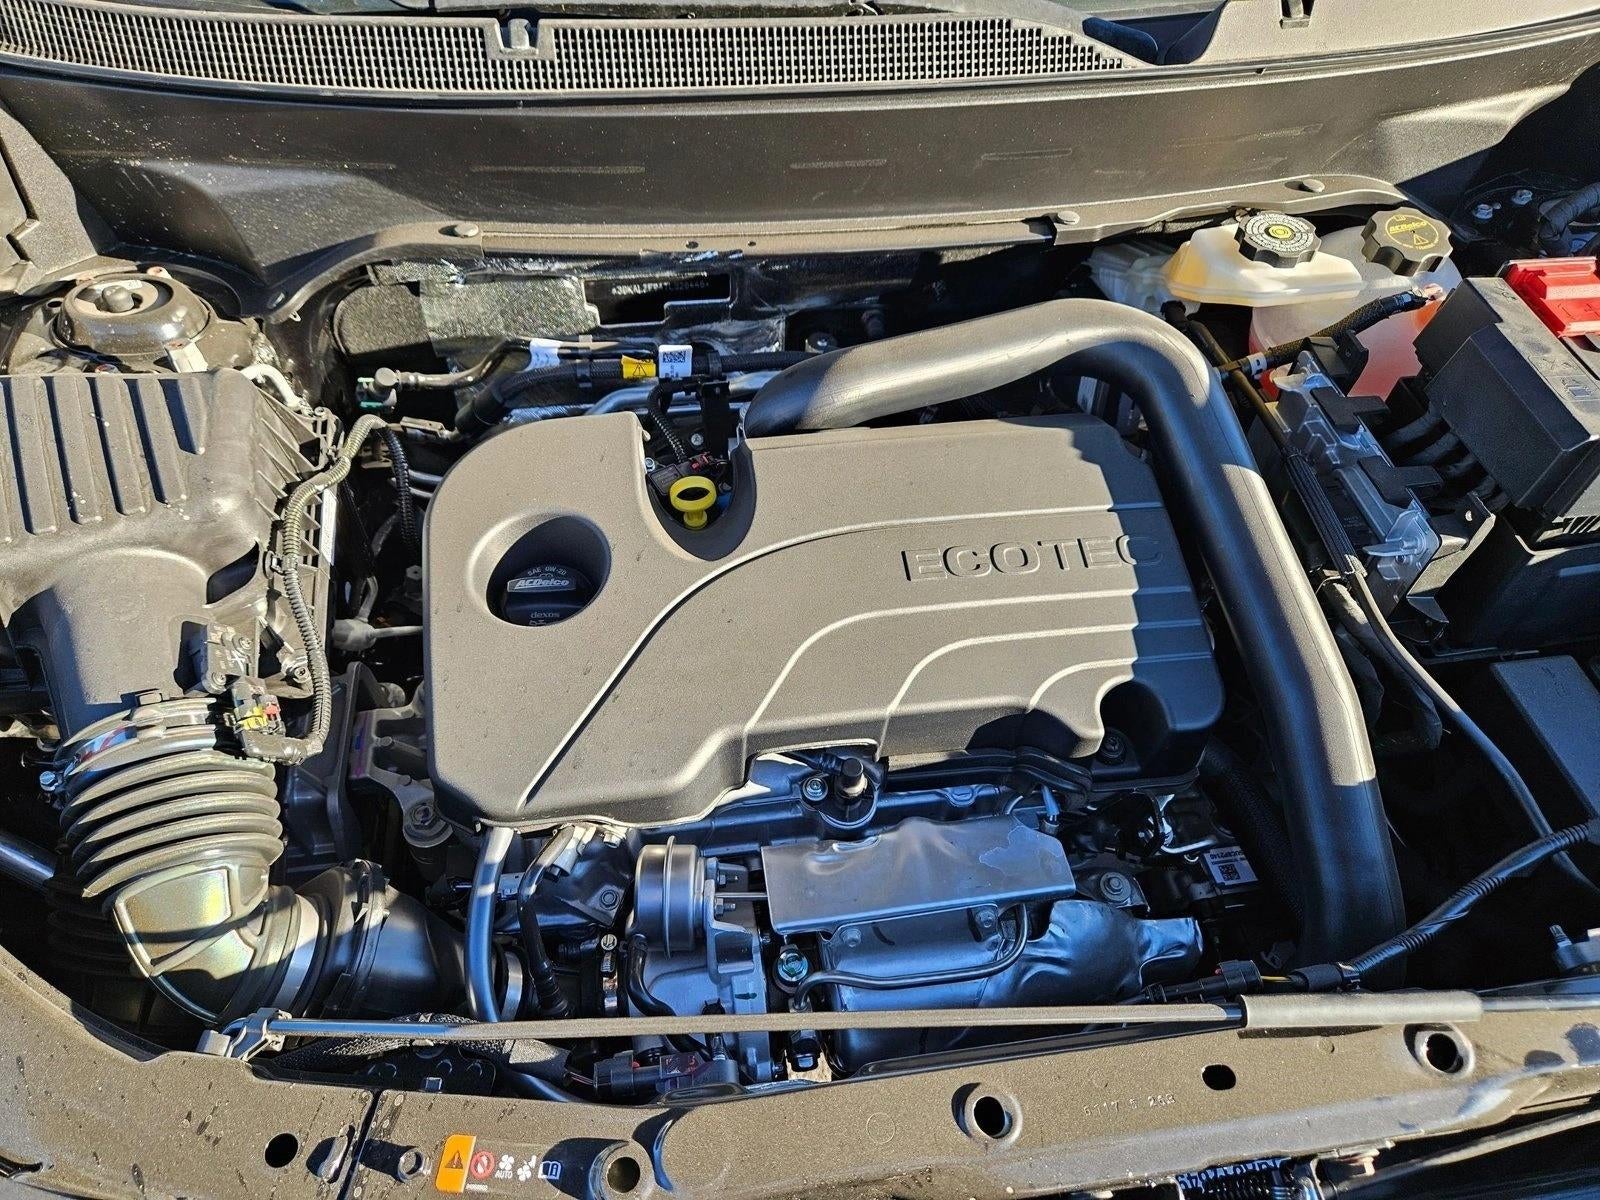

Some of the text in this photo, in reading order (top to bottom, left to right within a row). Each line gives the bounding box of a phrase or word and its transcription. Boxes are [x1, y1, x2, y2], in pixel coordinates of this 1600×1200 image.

[900, 534, 1164, 582] ECOTEC
[527, 565, 567, 576] SAE 0W-20
[514, 577, 570, 589] ACDelco
[494, 1169, 513, 1180] AUTO
